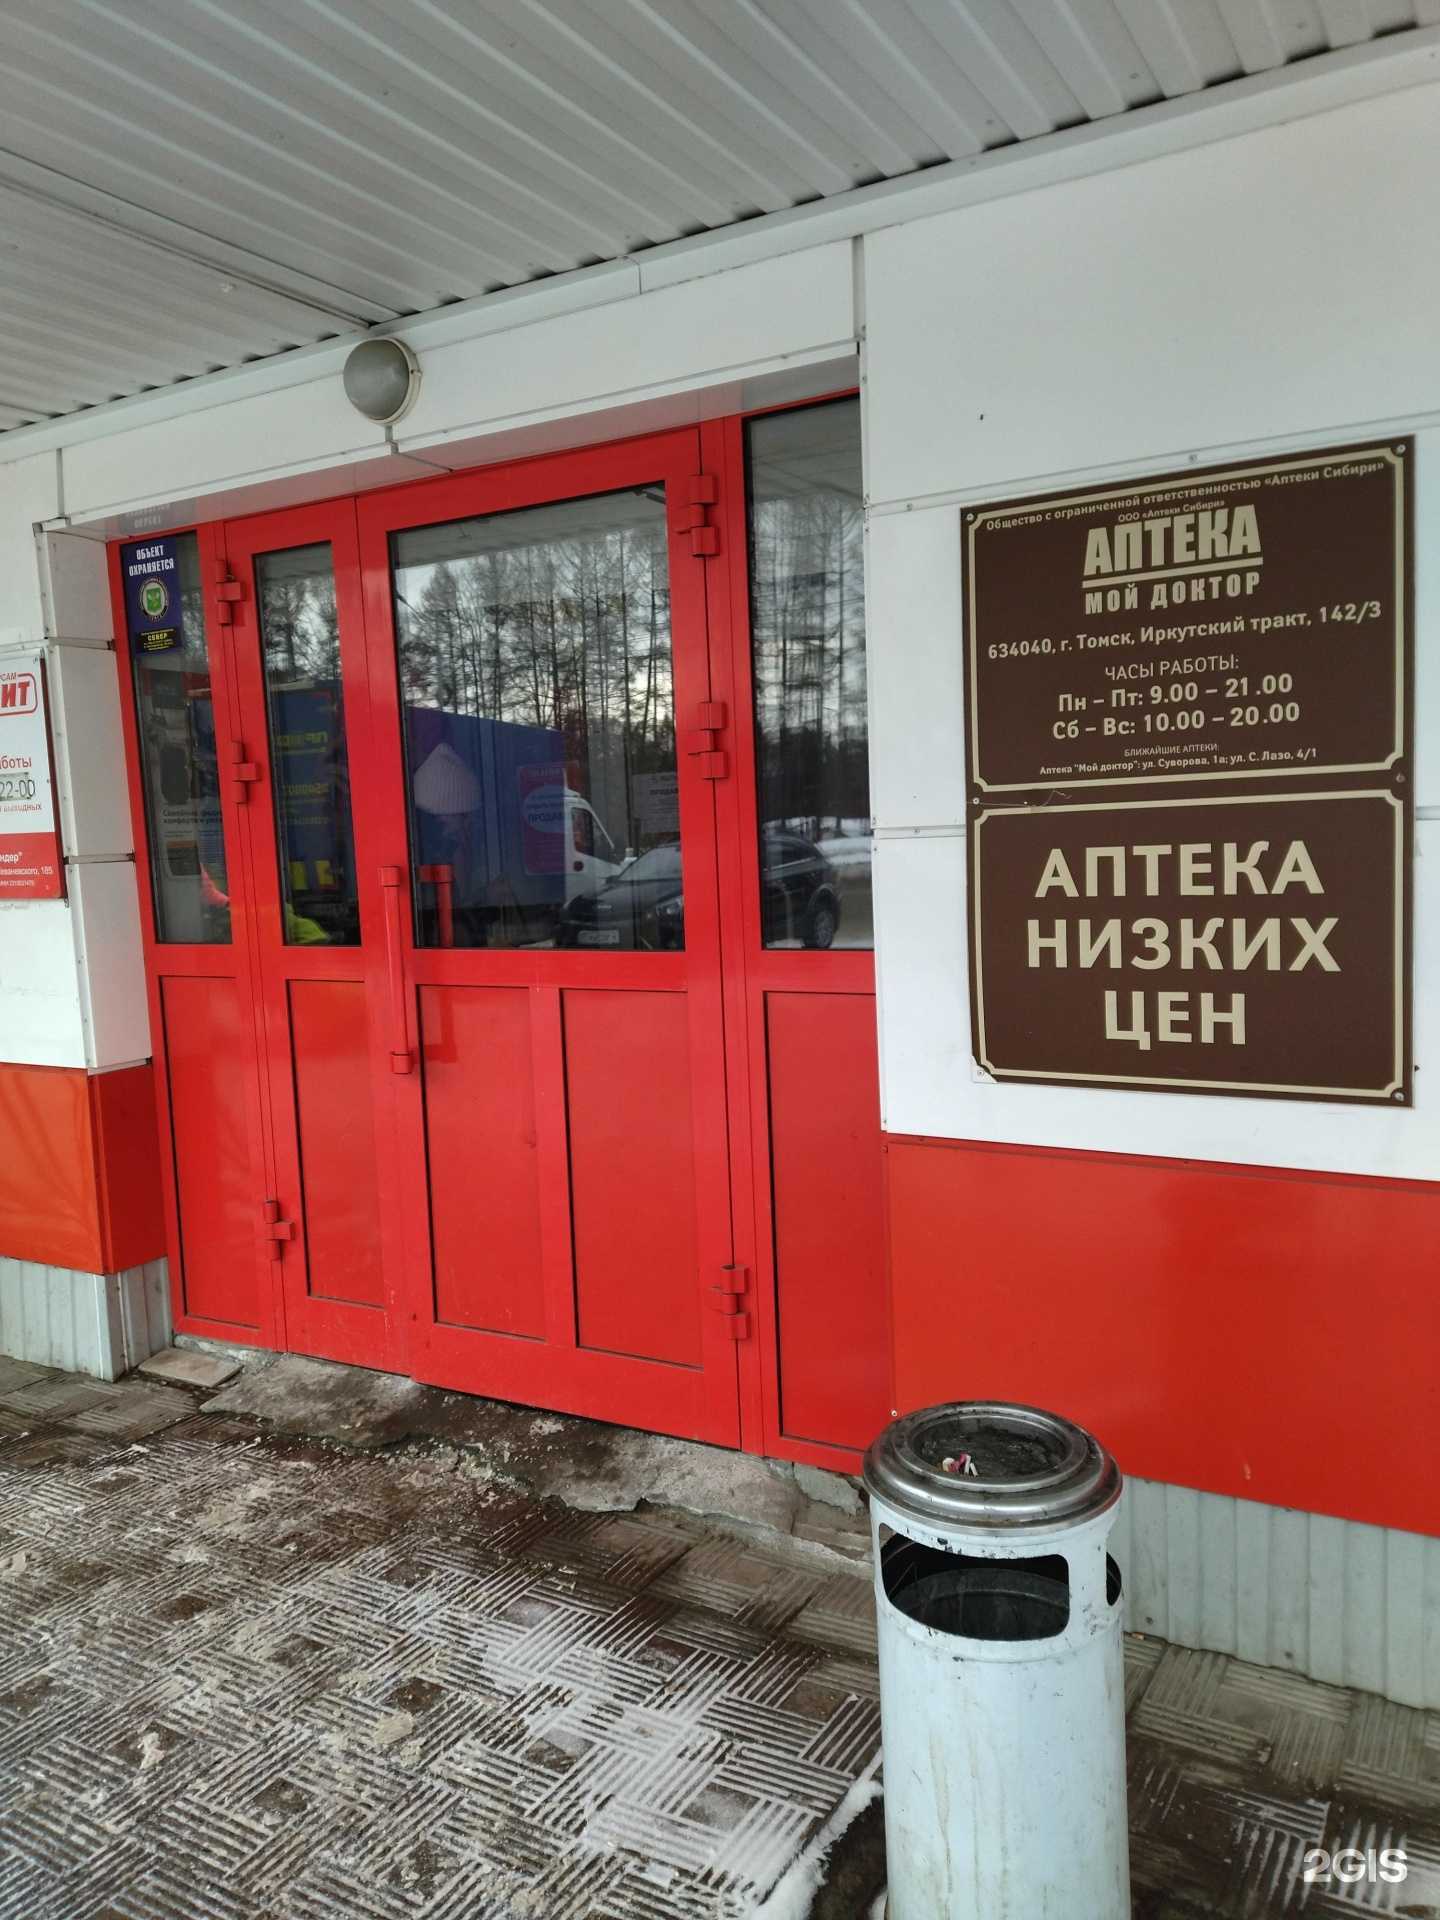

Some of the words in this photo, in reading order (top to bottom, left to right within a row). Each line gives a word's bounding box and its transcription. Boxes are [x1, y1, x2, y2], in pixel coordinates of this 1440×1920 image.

[987, 513, 1042, 530] Общество
[1045, 512, 1052, 520] с
[1054, 495, 1140, 519] ограниченной
[1143, 479, 1261, 504] ответственностью
[1264, 470, 1320, 486] «Аптеки
[1323, 462, 1384, 479] Сибири»
[1118, 511, 1139, 522] ООО
[136, 545, 164, 560] ОБЪЕКТ
[1083, 504, 1262, 576] АПТЕКА
[128, 558, 174, 576] ОХРАНЯЕТСЯ
[1085, 583, 1138, 615] МОЙ
[1150, 572, 1260, 610] ДОКТОР
[988, 638, 1056, 659] 634040,
[1060, 639, 1073, 652] г.
[1076, 631, 1135, 650] Томск,
[1140, 615, 1245, 642] Иркутский
[1250, 612, 1312, 633] тракт,
[1319, 601, 1382, 625] 142/3
[1105, 662, 1154, 681] ЧАСЫ
[1159, 654, 1239, 675] РАБОТЫ:
[1058, 694, 1087, 712] Пн
[1111, 689, 1143, 708] Пт:
[1150, 682, 1199, 705] 9.00
[1053, 720, 1080, 740] Сб
[1103, 717, 1136, 736] Вс:
[1144, 710, 1205, 733] 10.00
[1229, 702, 1300, 727] 20.00
[1040, 766, 1073, 775] Аптека
[1074, 763, 1098, 773] "Мой
[1142, 761, 1156, 771] ул.
[1158, 757, 1210, 769] Суворова,
[1230, 755, 1246, 765] ул.
[1249, 752, 1259, 762] С.
[1296, 748, 1317, 760] 4/1
[1124, 745, 1181, 757] БЛИЖАЙШИЕ
[1035, 840, 1325, 898] АПТЕКА
[1027, 917, 1342, 972] НИЗКИХ
[1105, 990, 1246, 1050] ЦЕН
